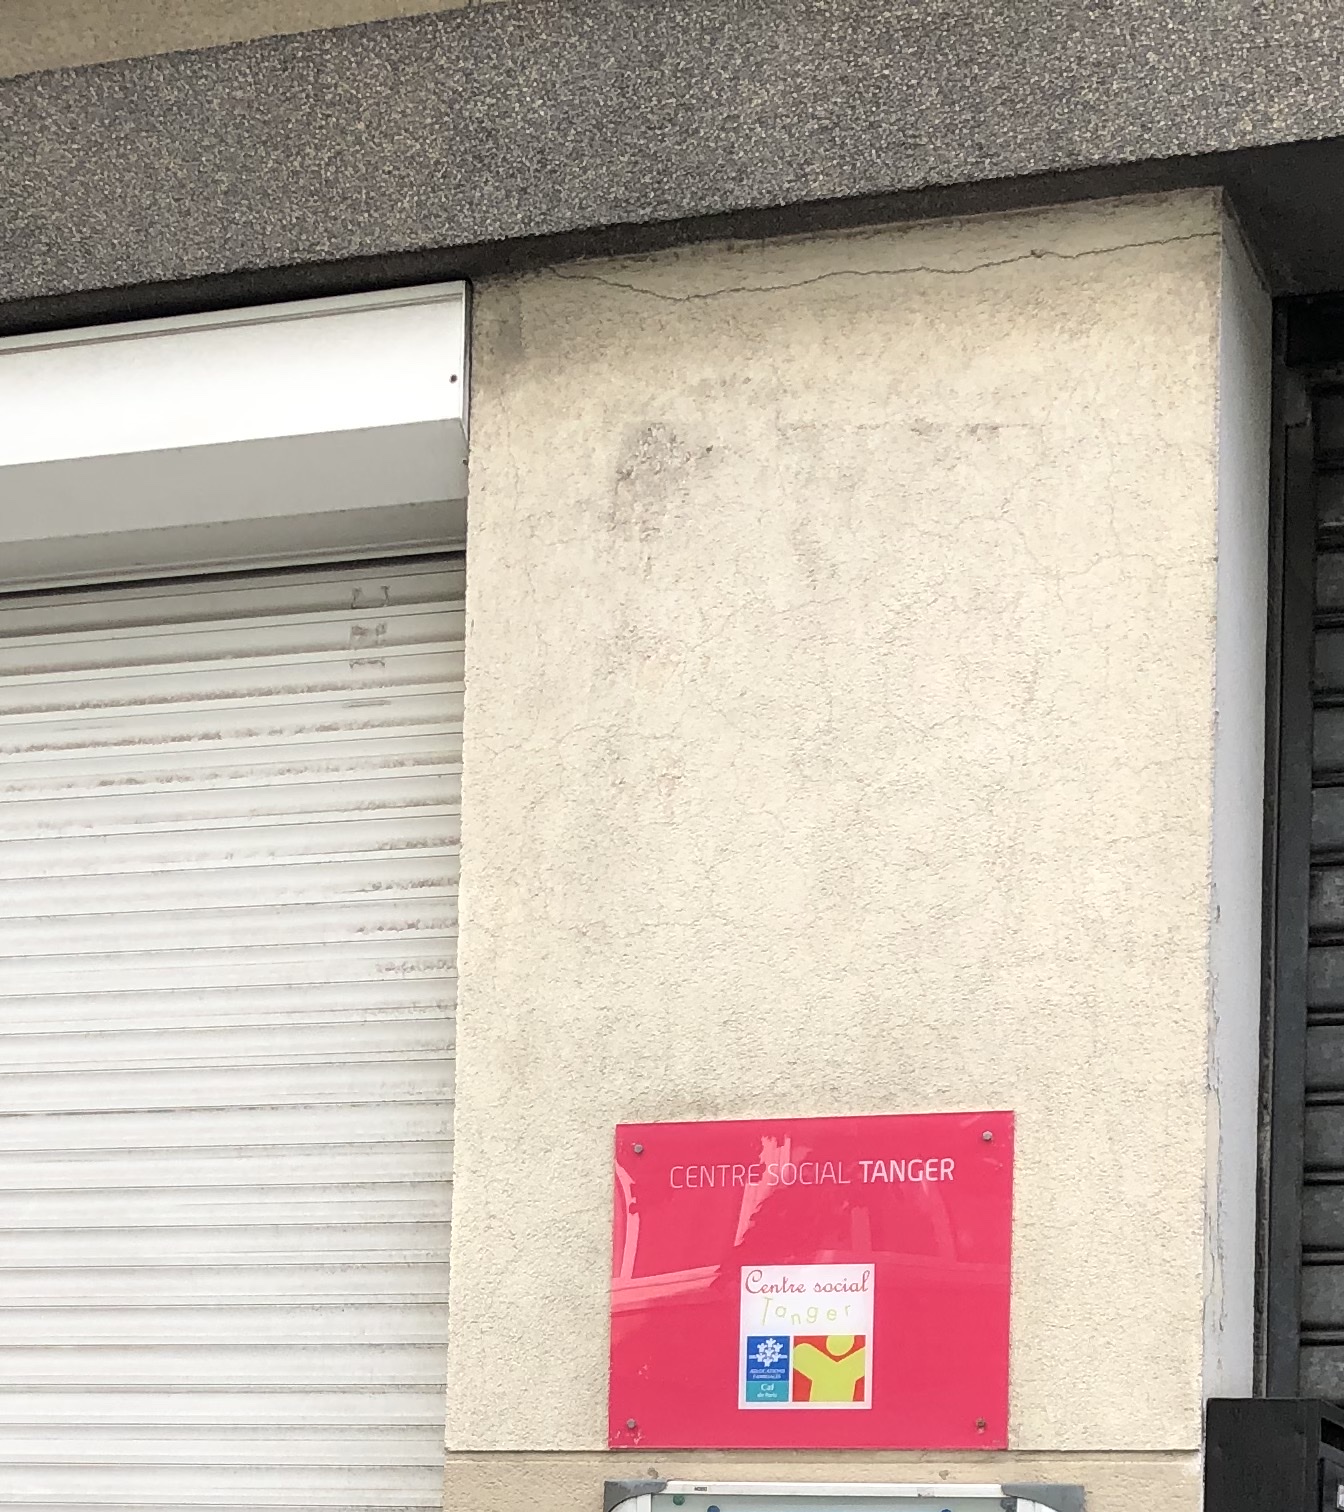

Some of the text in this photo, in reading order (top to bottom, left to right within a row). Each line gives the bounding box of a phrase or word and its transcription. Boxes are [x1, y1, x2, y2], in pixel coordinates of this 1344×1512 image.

[670, 1158, 955, 1188] CENTRE SOCIAL TANGER
[745, 1269, 870, 1295] Centre social
[762, 1296, 852, 1326] Tanger
